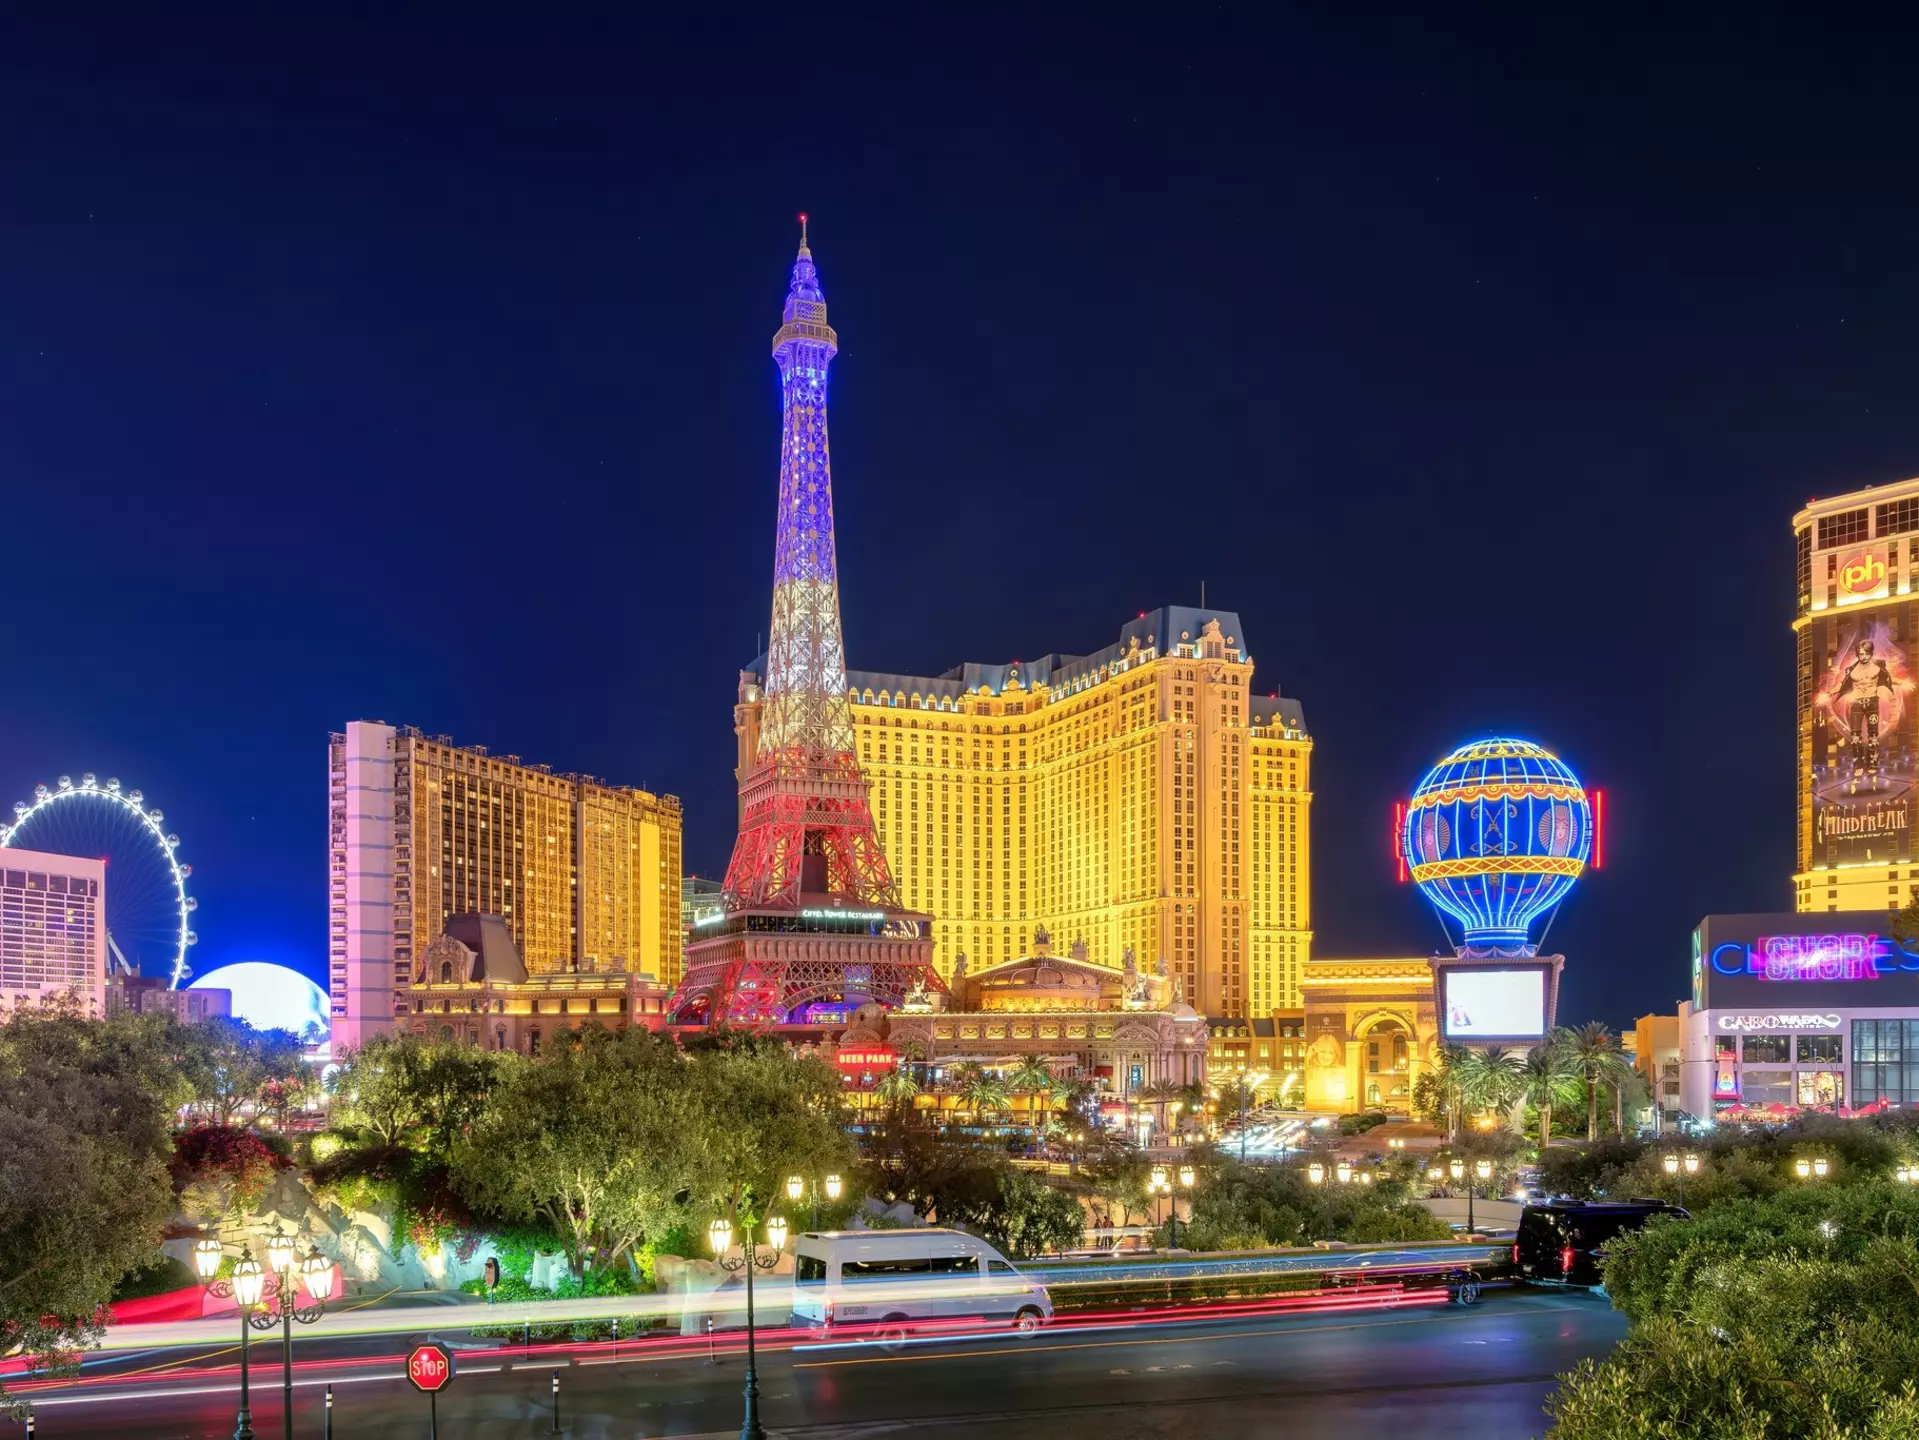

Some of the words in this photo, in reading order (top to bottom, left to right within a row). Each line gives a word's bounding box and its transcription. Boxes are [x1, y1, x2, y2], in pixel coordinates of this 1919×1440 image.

[1845, 554, 1884, 590] ph
[1824, 810, 1908, 835] MINDFREAK
[824, 910, 846, 919] TOWER
[848, 911, 884, 920] RESTAURANT
[1718, 1015, 1780, 1031] CABO
[839, 1054, 864, 1063] BEER
[866, 1054, 892, 1063] PARK
[412, 1360, 445, 1376] STOP
